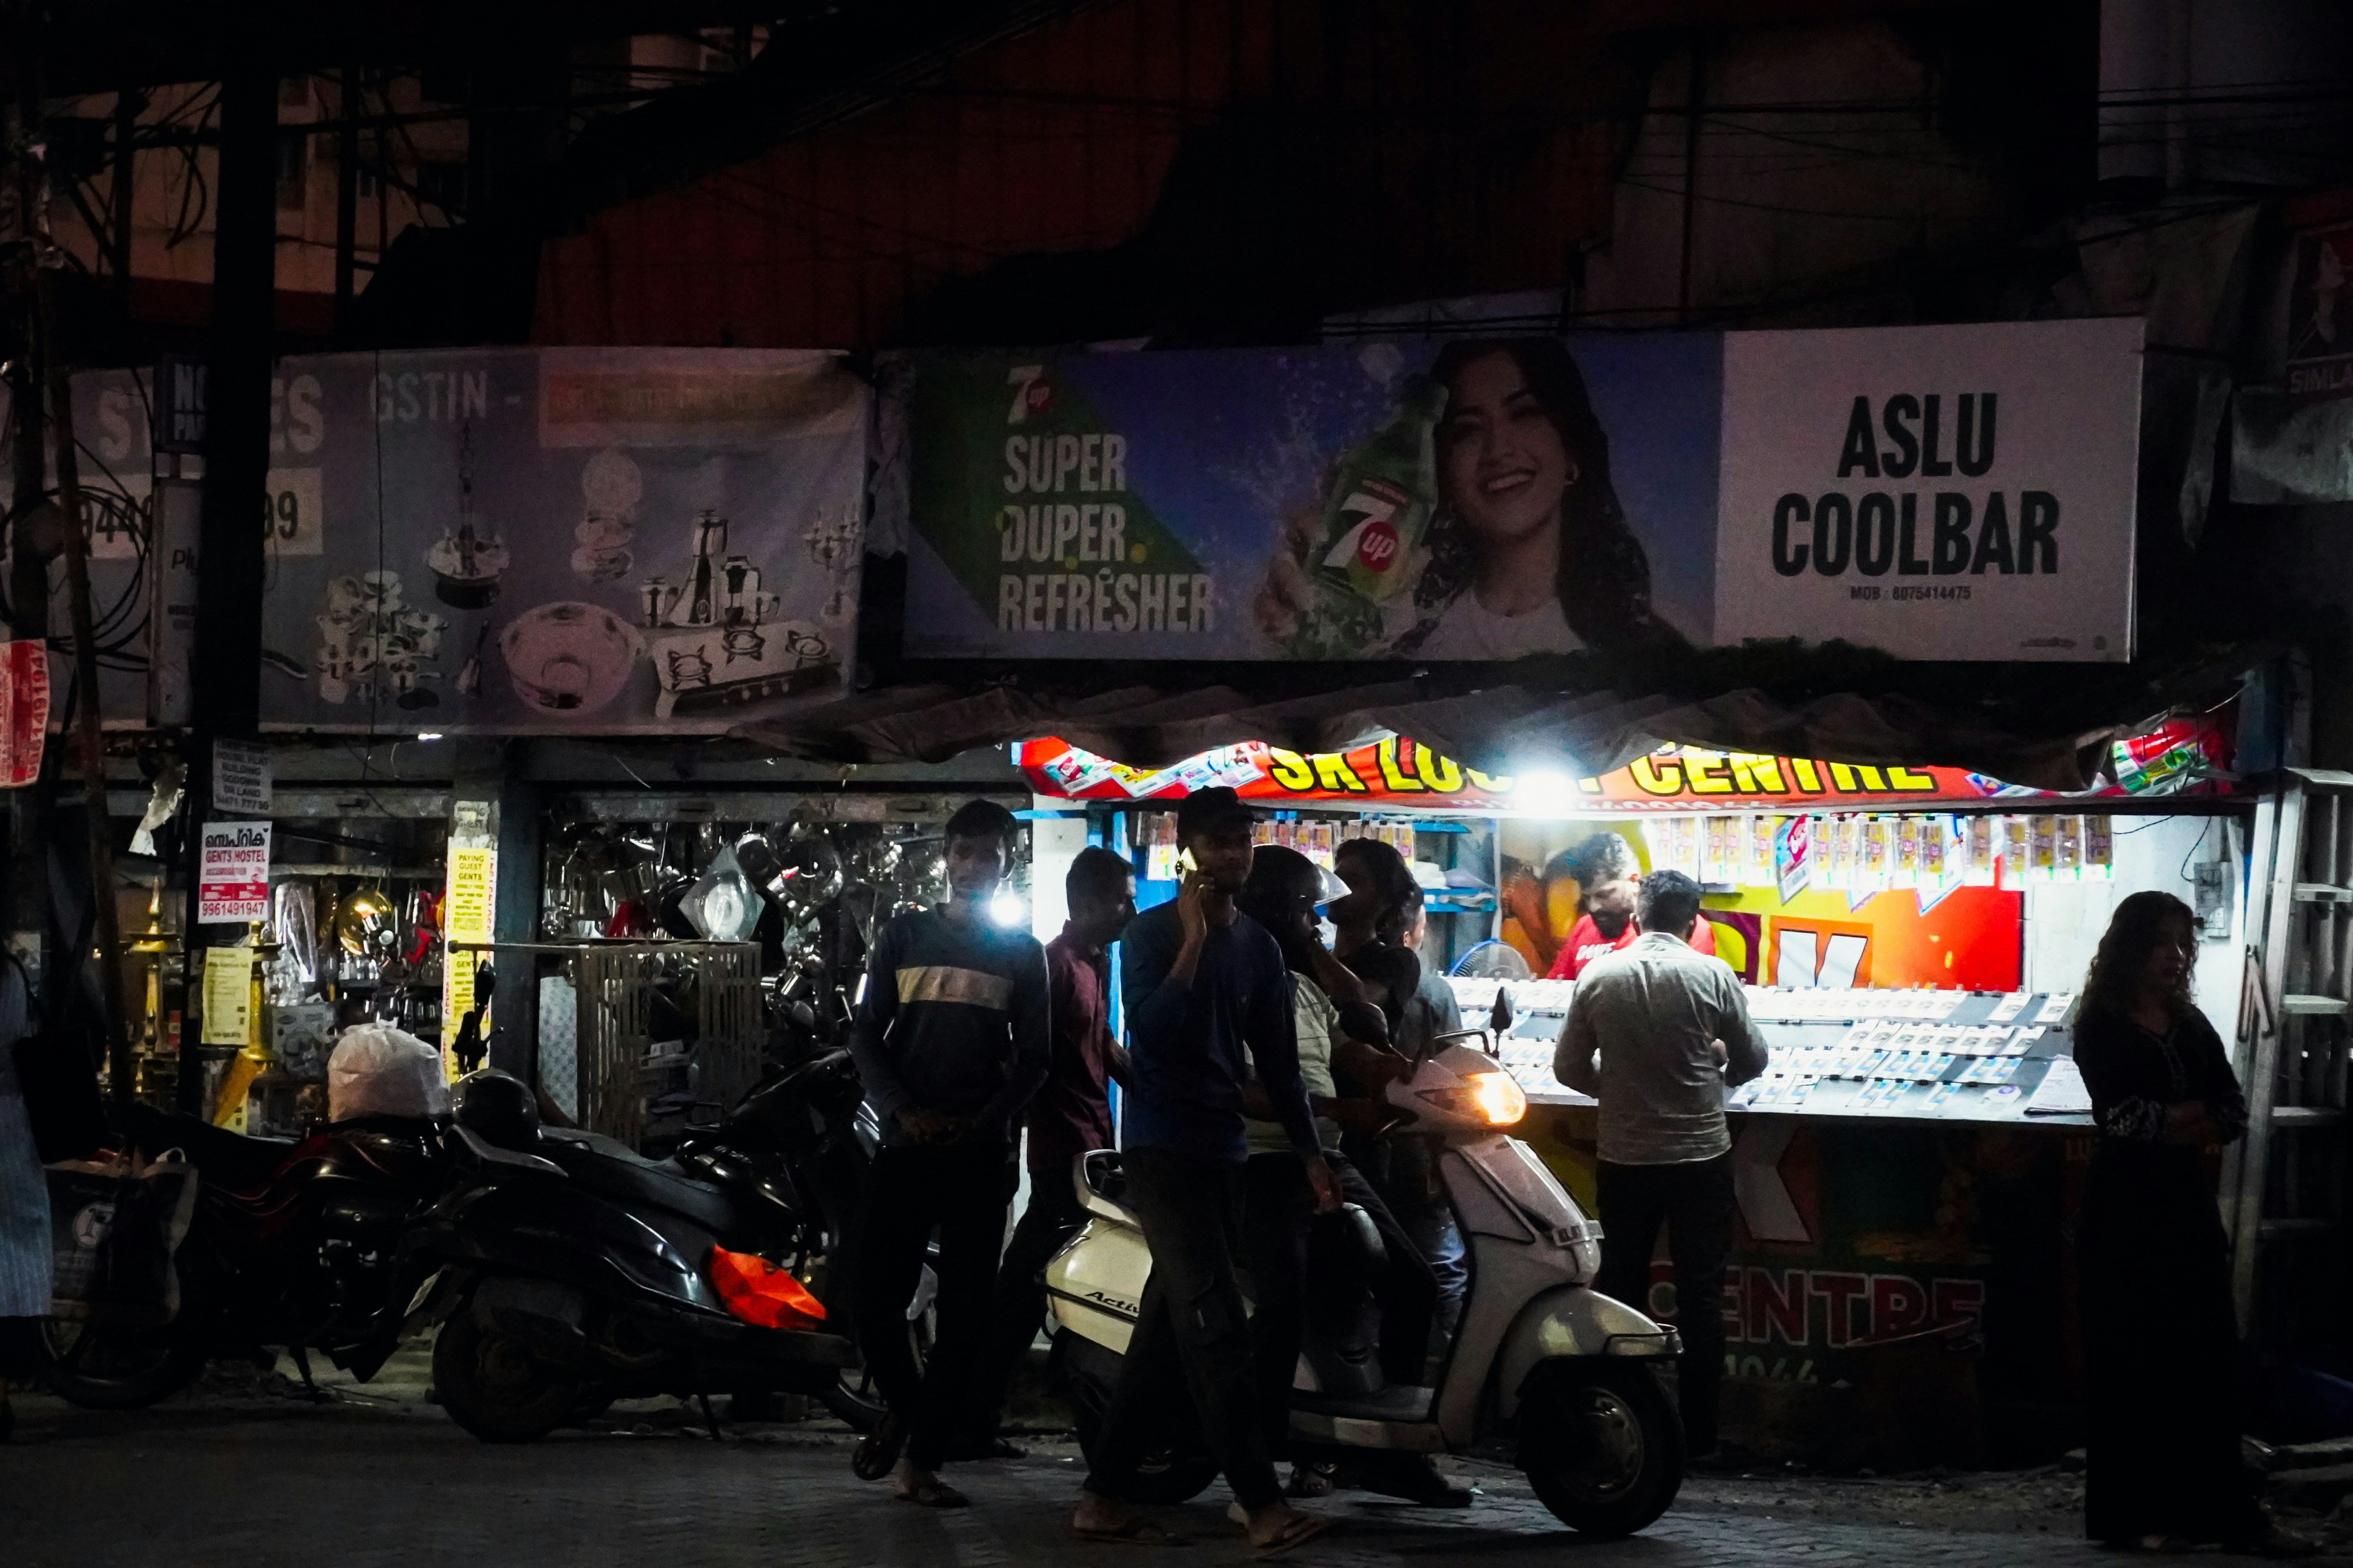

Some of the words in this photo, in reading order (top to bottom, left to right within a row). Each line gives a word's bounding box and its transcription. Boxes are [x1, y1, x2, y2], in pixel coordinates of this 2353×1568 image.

[369, 371, 487, 421] GSTIN
[1003, 433, 1127, 494] SUPER
[1837, 393, 1997, 478] ASLU
[1001, 504, 1126, 562] DUPER
[1772, 490, 2060, 577] COOLBAR
[998, 572, 1216, 631] REFRESHER
[1850, 586, 1881, 600] MOB
[206, 850, 231, 863] GENTS
[234, 850, 265, 862] HOSTEL
[202, 902, 264, 916] 9961491947
